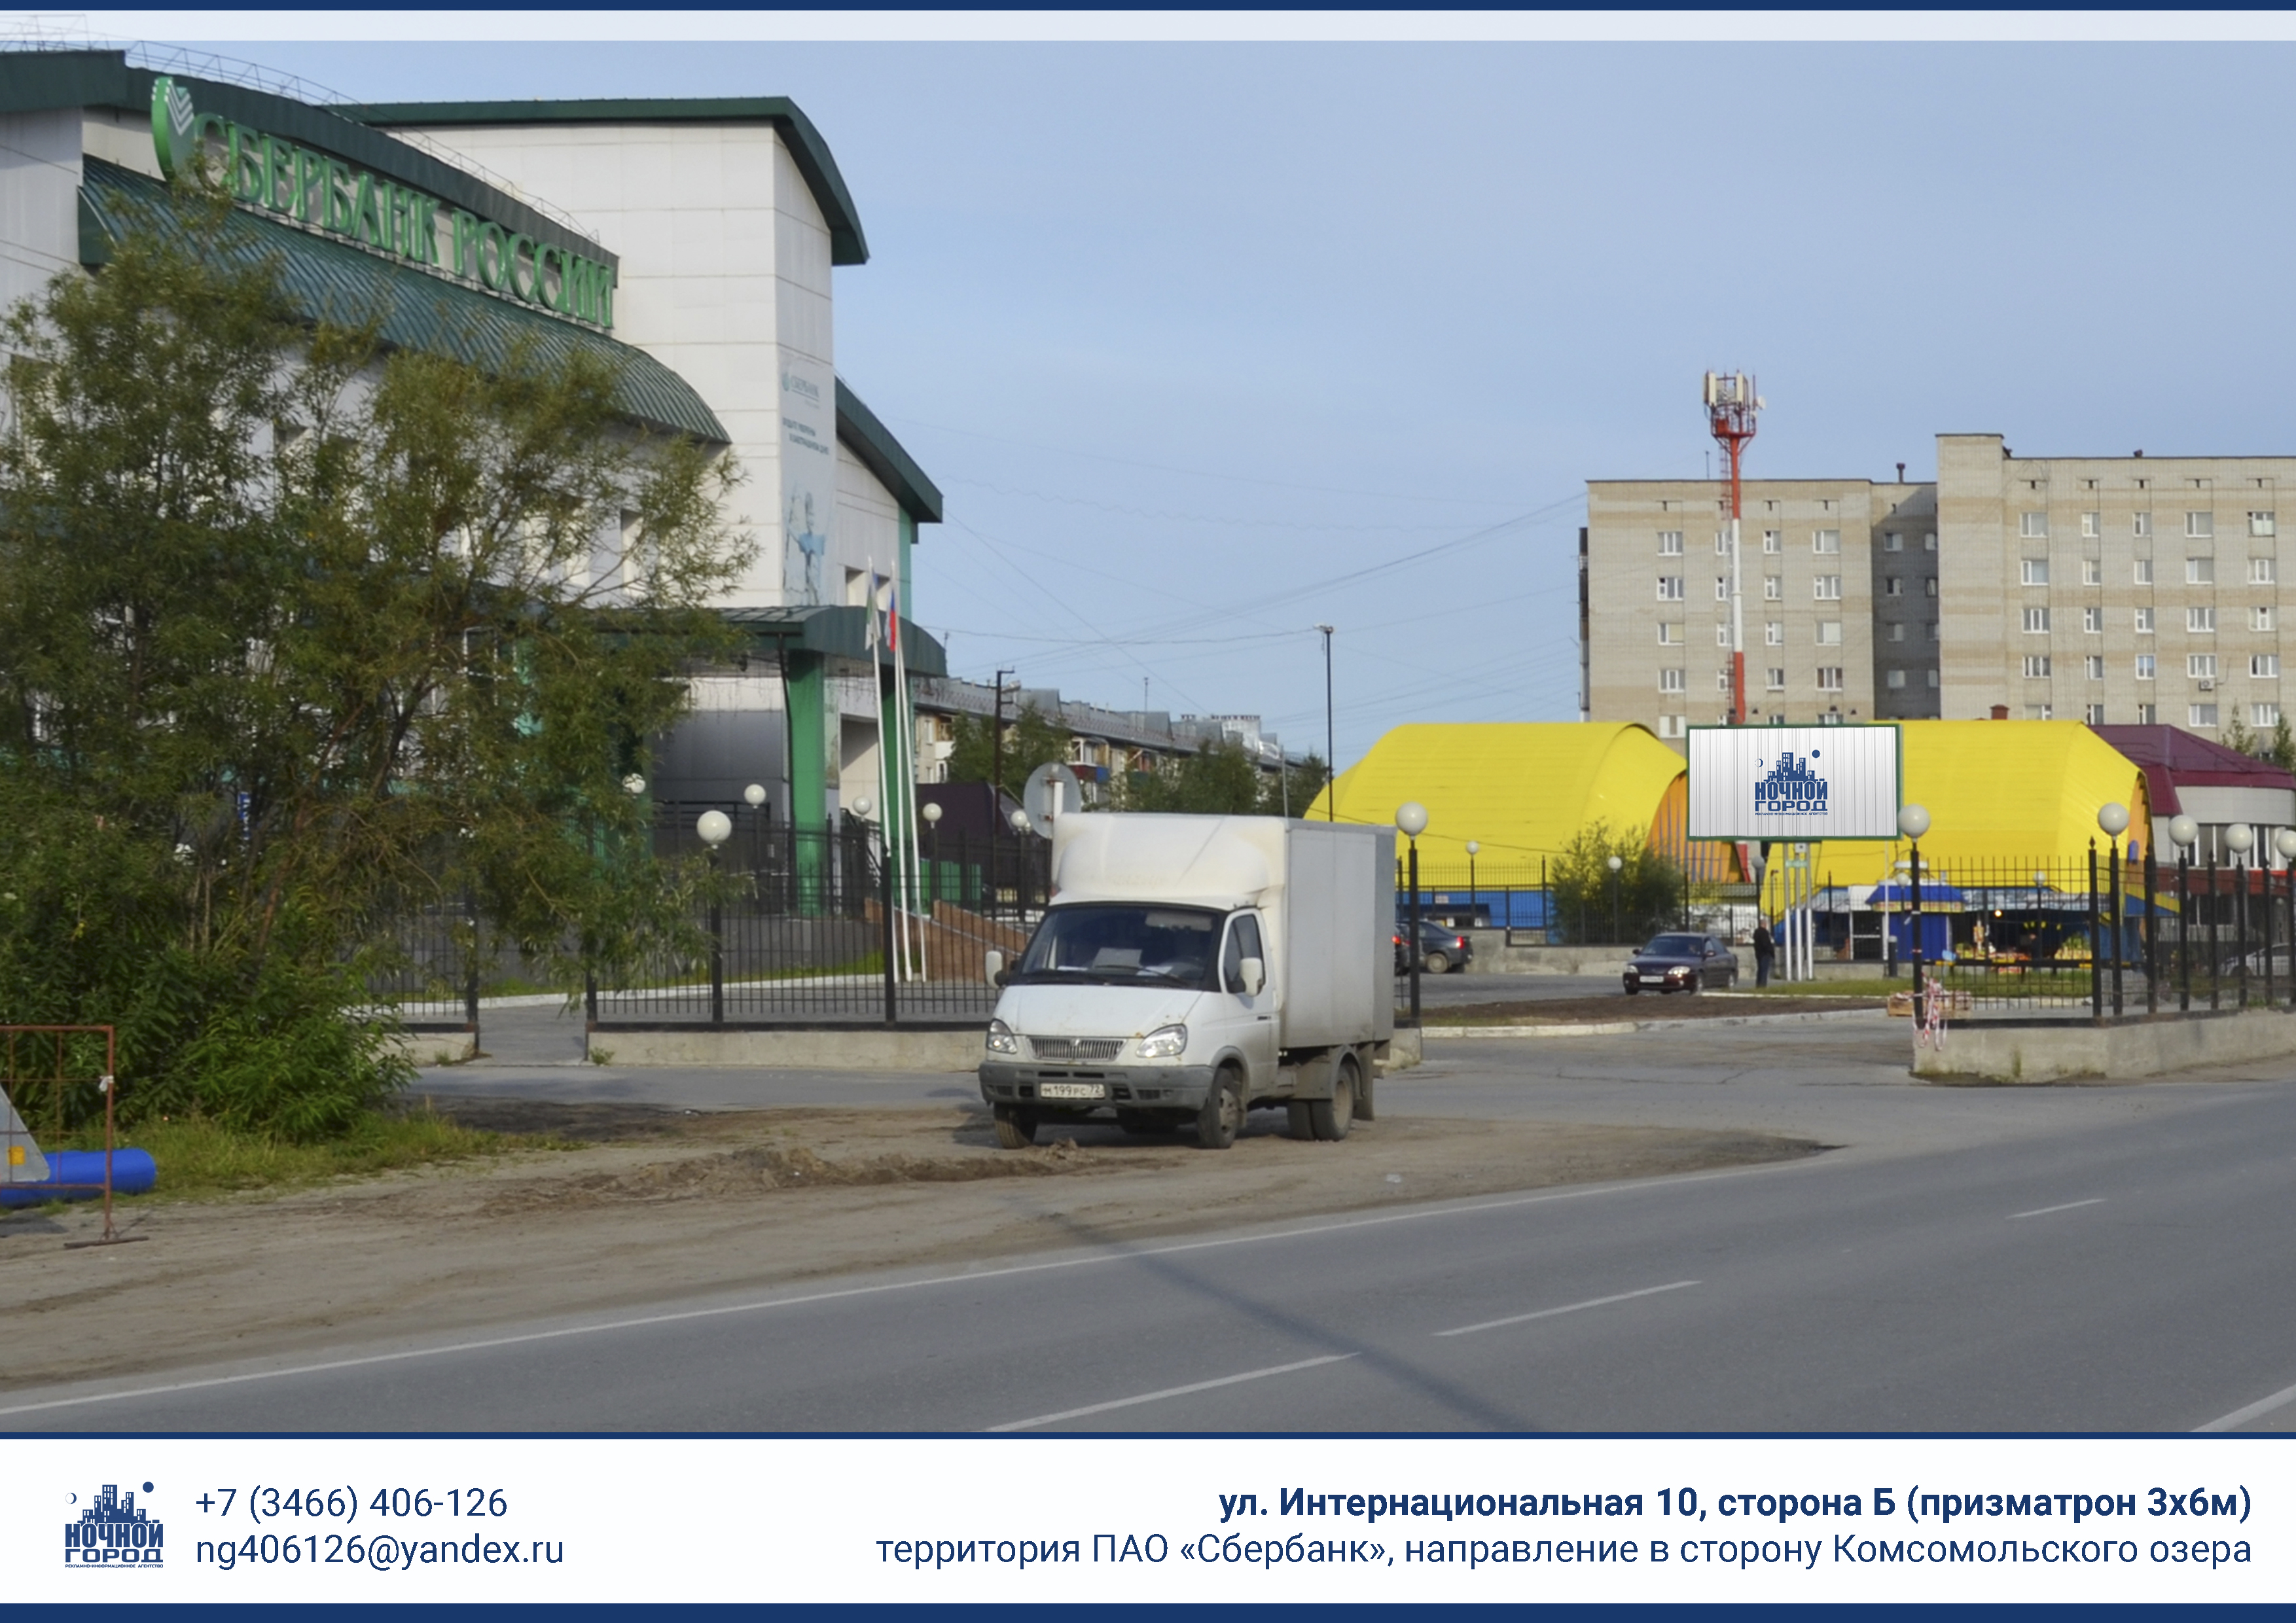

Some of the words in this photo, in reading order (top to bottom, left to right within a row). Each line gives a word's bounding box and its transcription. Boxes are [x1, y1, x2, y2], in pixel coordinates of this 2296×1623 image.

[194, 112, 440, 266] СБЕРБАНК
[452, 206, 615, 329] РОССИИ
[1755, 778, 1827, 800] НОЧНОЙ
[1755, 800, 1827, 812] ГОРОД
